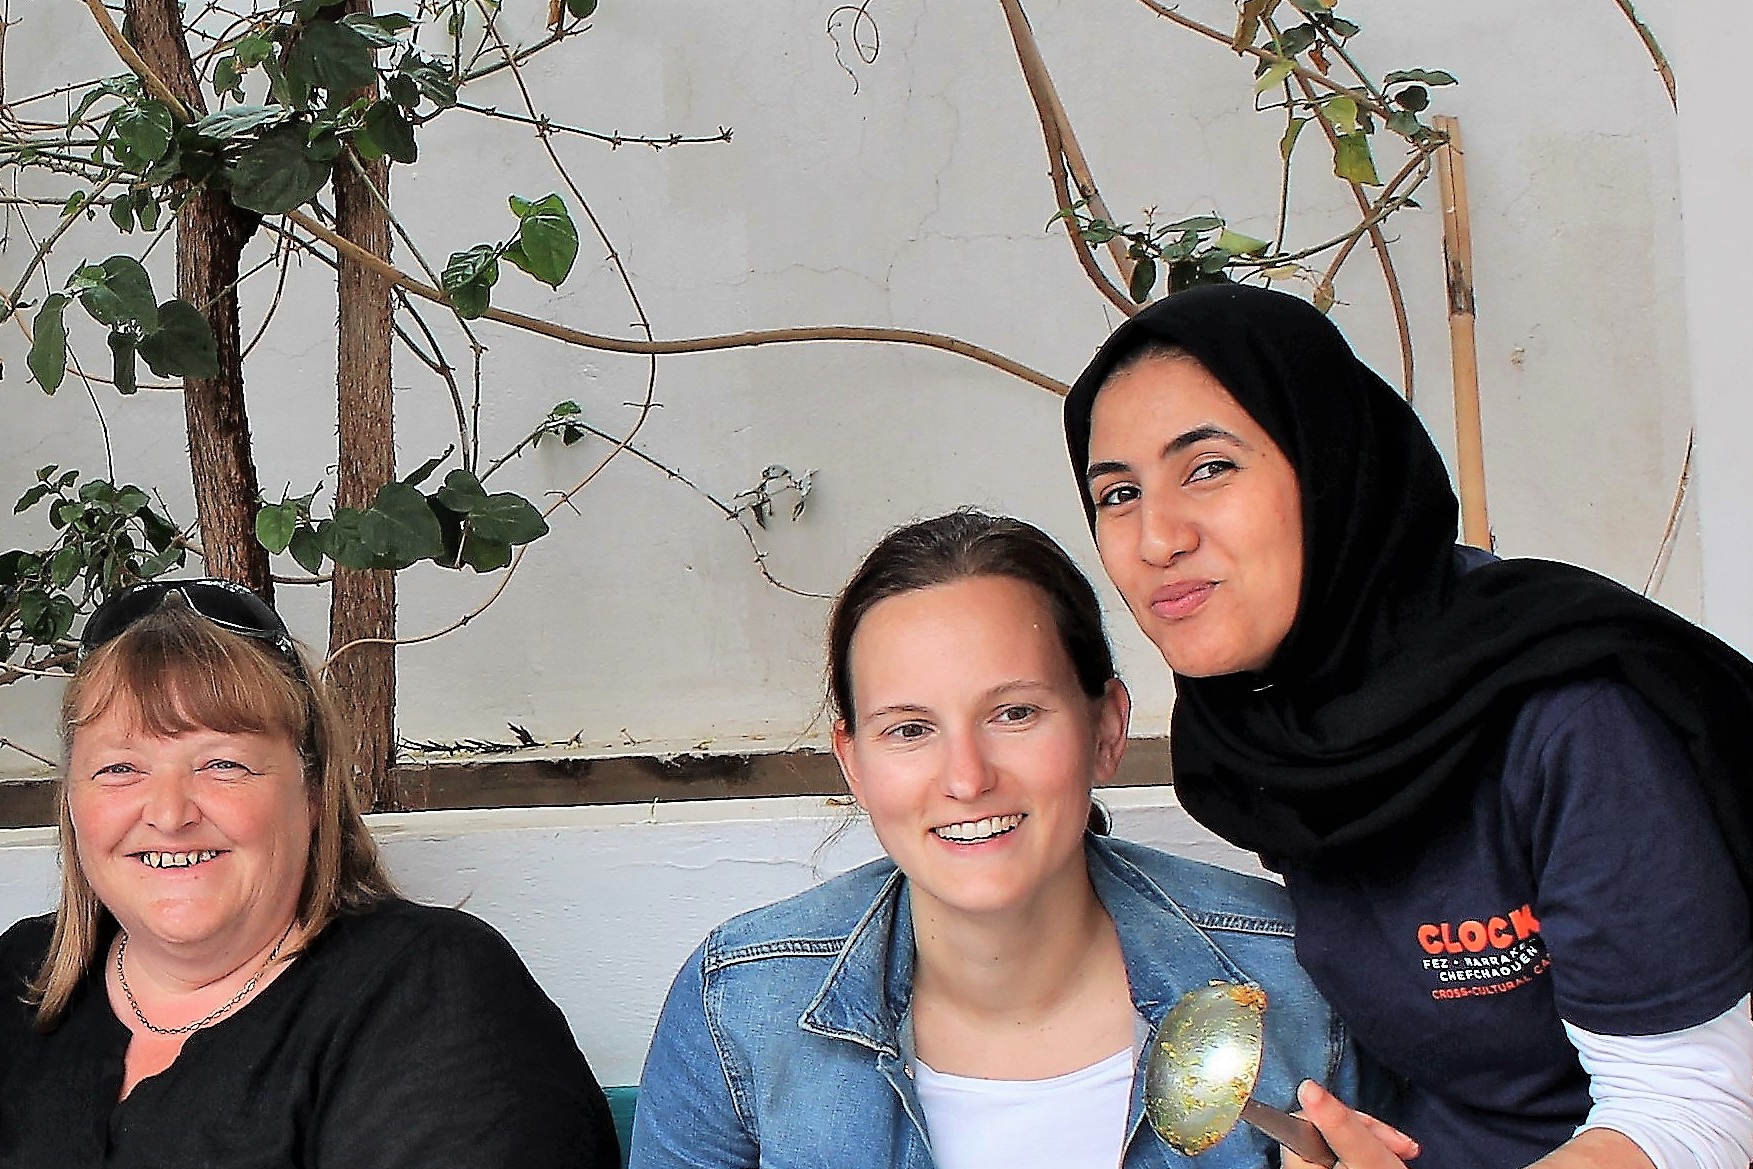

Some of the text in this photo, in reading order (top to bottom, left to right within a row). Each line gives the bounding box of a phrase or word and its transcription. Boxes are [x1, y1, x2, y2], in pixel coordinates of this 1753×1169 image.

[1417, 903, 1542, 954] CLOCK
[1422, 959, 1449, 970] FEZ
[1439, 945, 1538, 982] CHEFCHAOUEN
